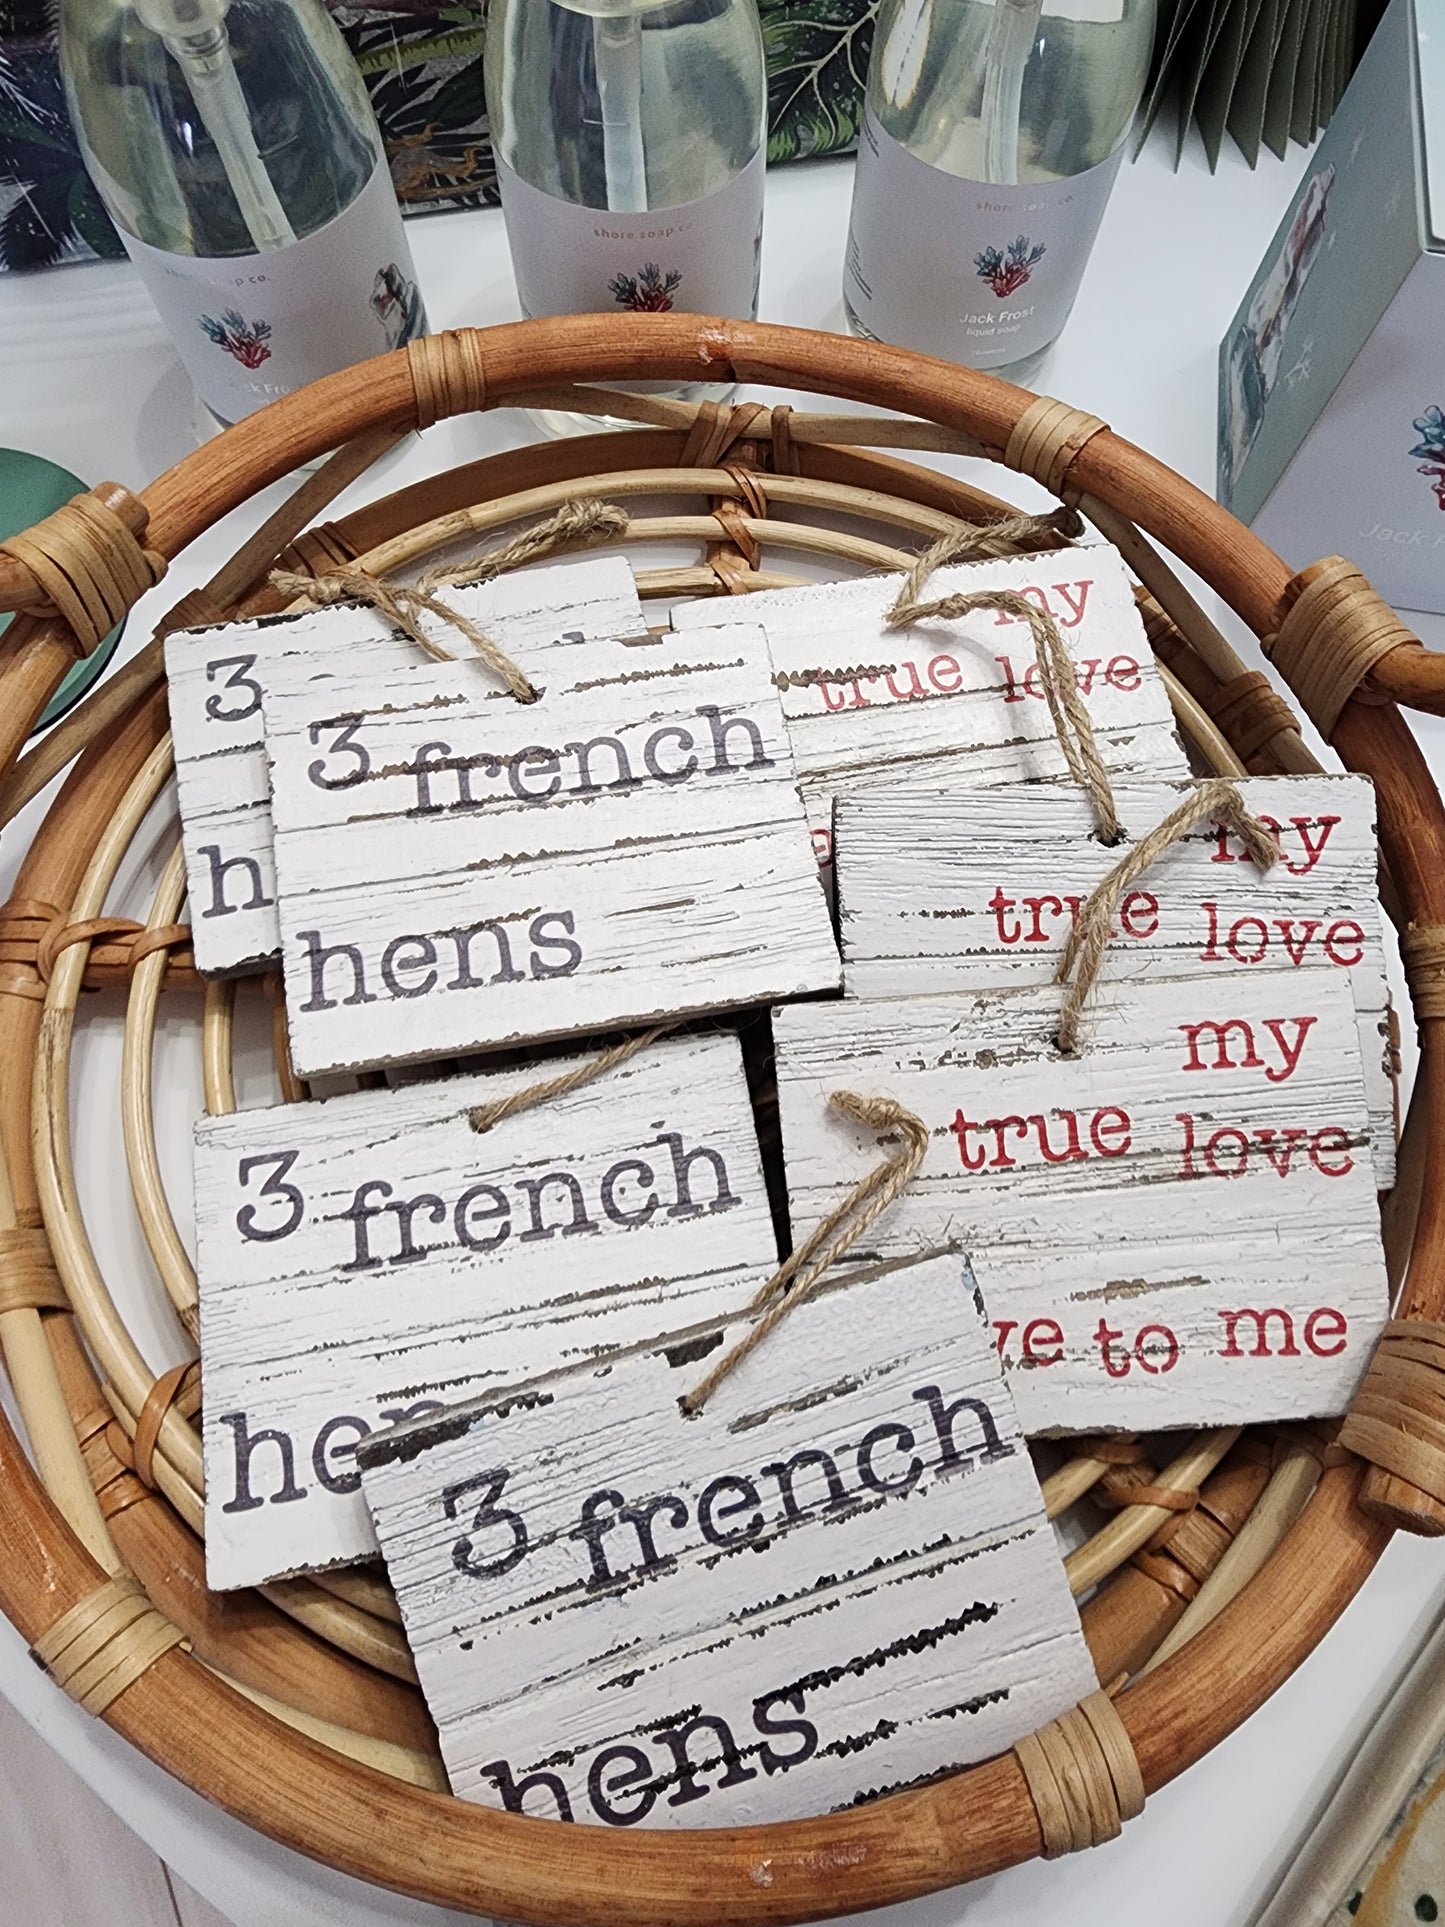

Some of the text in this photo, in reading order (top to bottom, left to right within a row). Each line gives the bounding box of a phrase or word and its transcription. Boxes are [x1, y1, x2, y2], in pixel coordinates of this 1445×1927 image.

[593, 228, 635, 240] shore
[639, 227, 674, 238] soap
[959, 305, 1035, 324] Jack Frost
[966, 327, 996, 338] liquid
[1359, 521, 1426, 545] Jack
[205, 654, 263, 722] 3
[816, 655, 962, 711] true
[307, 706, 776, 819] 3 french
[296, 910, 582, 1012] hens
[1199, 902, 1365, 966] love
[1179, 1016, 1318, 1082] my
[948, 1105, 1355, 1180] true love
[236, 1132, 742, 1272] 3 french
[1093, 1317, 1180, 1377] to
[1218, 1306, 1348, 1357] me
[441, 1385, 1014, 1592] 3 french
[480, 1692, 819, 1827] hens
